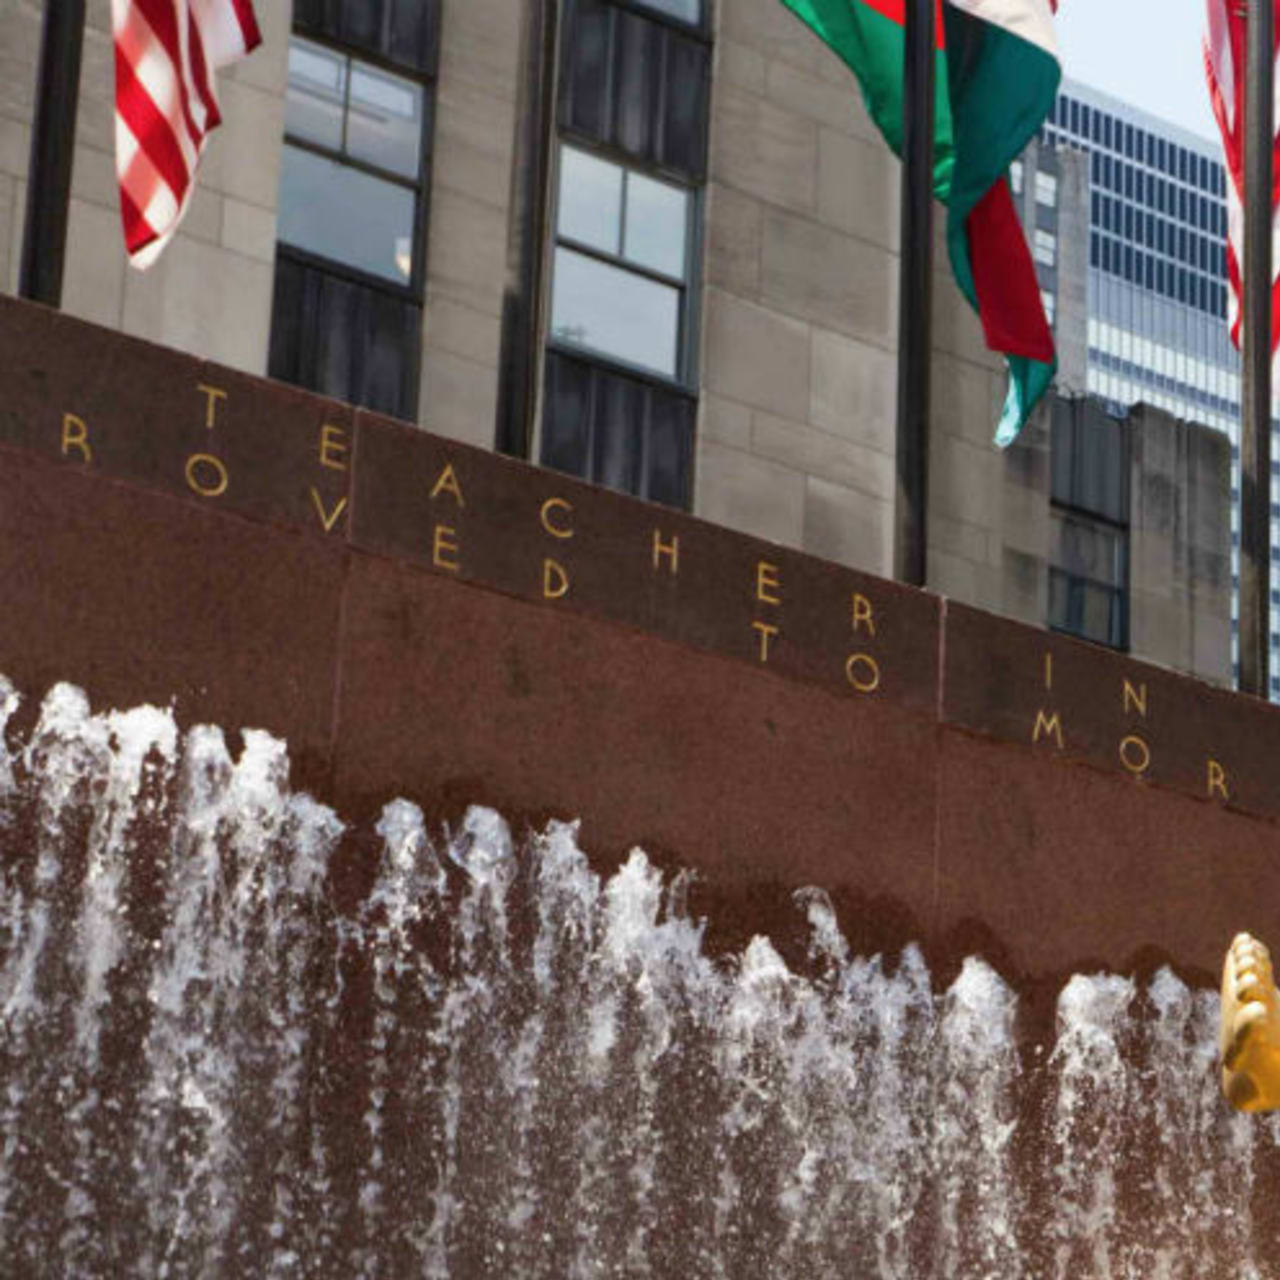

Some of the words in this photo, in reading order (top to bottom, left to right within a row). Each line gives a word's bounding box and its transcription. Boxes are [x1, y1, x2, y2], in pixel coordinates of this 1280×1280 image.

[197, 383, 876, 636] TEACHER
[1044, 652, 1148, 717] IN
[752, 621, 880, 692] TO
